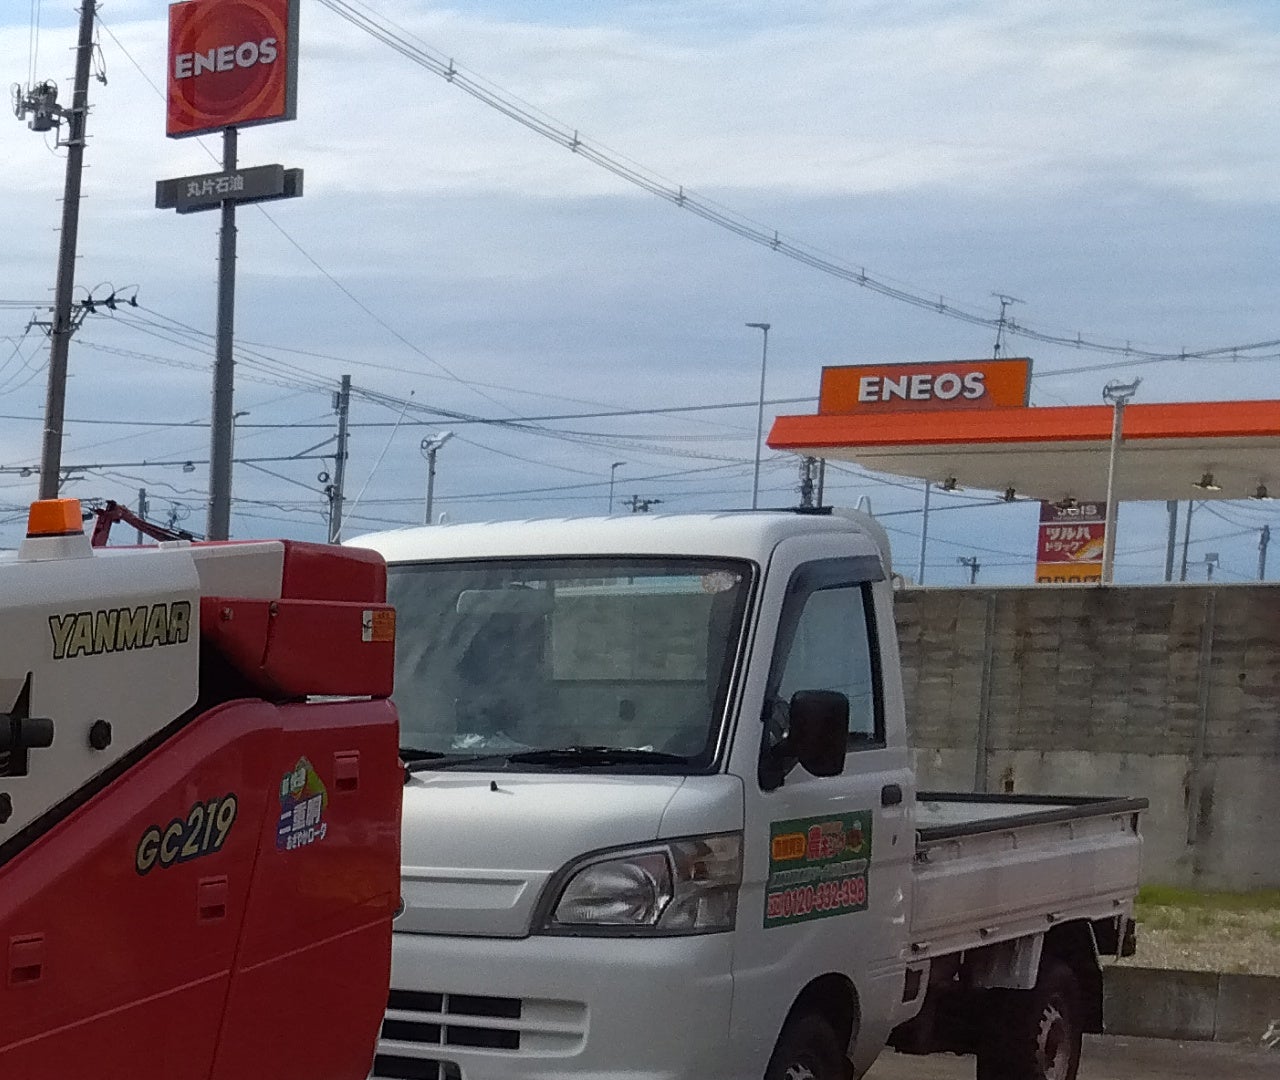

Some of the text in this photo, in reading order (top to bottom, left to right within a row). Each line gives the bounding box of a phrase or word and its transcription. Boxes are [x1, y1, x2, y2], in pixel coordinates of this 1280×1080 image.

[175, 37, 278, 79] ENEOS
[858, 372, 986, 402] ENEOS
[1045, 526, 1091, 541] ツルハ
[48, 601, 191, 660] YANMAR
[136, 793, 239, 875] GC219
